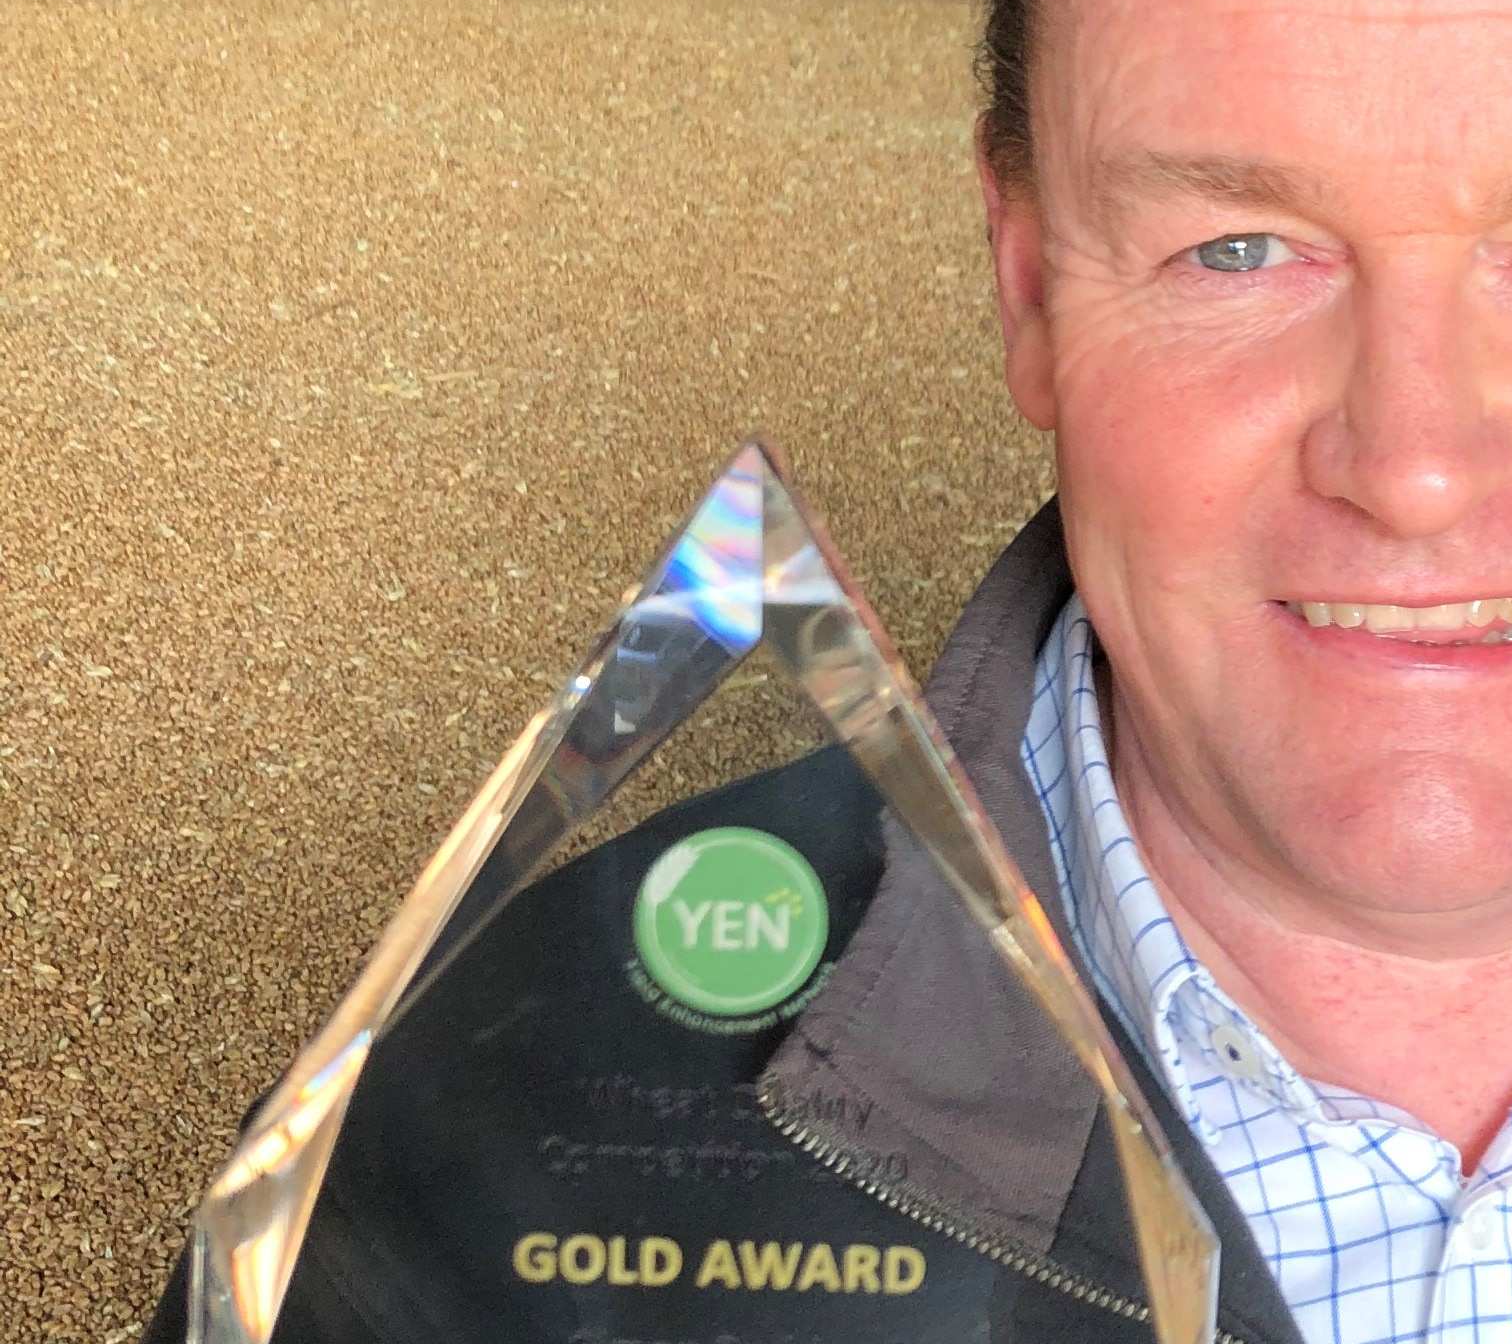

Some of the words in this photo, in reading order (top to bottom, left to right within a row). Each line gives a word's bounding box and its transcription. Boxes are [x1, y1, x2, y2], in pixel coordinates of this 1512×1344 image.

[672, 899, 792, 951] YEN
[512, 1232, 684, 1288] GOLD
[696, 1238, 928, 1296] AWARD
